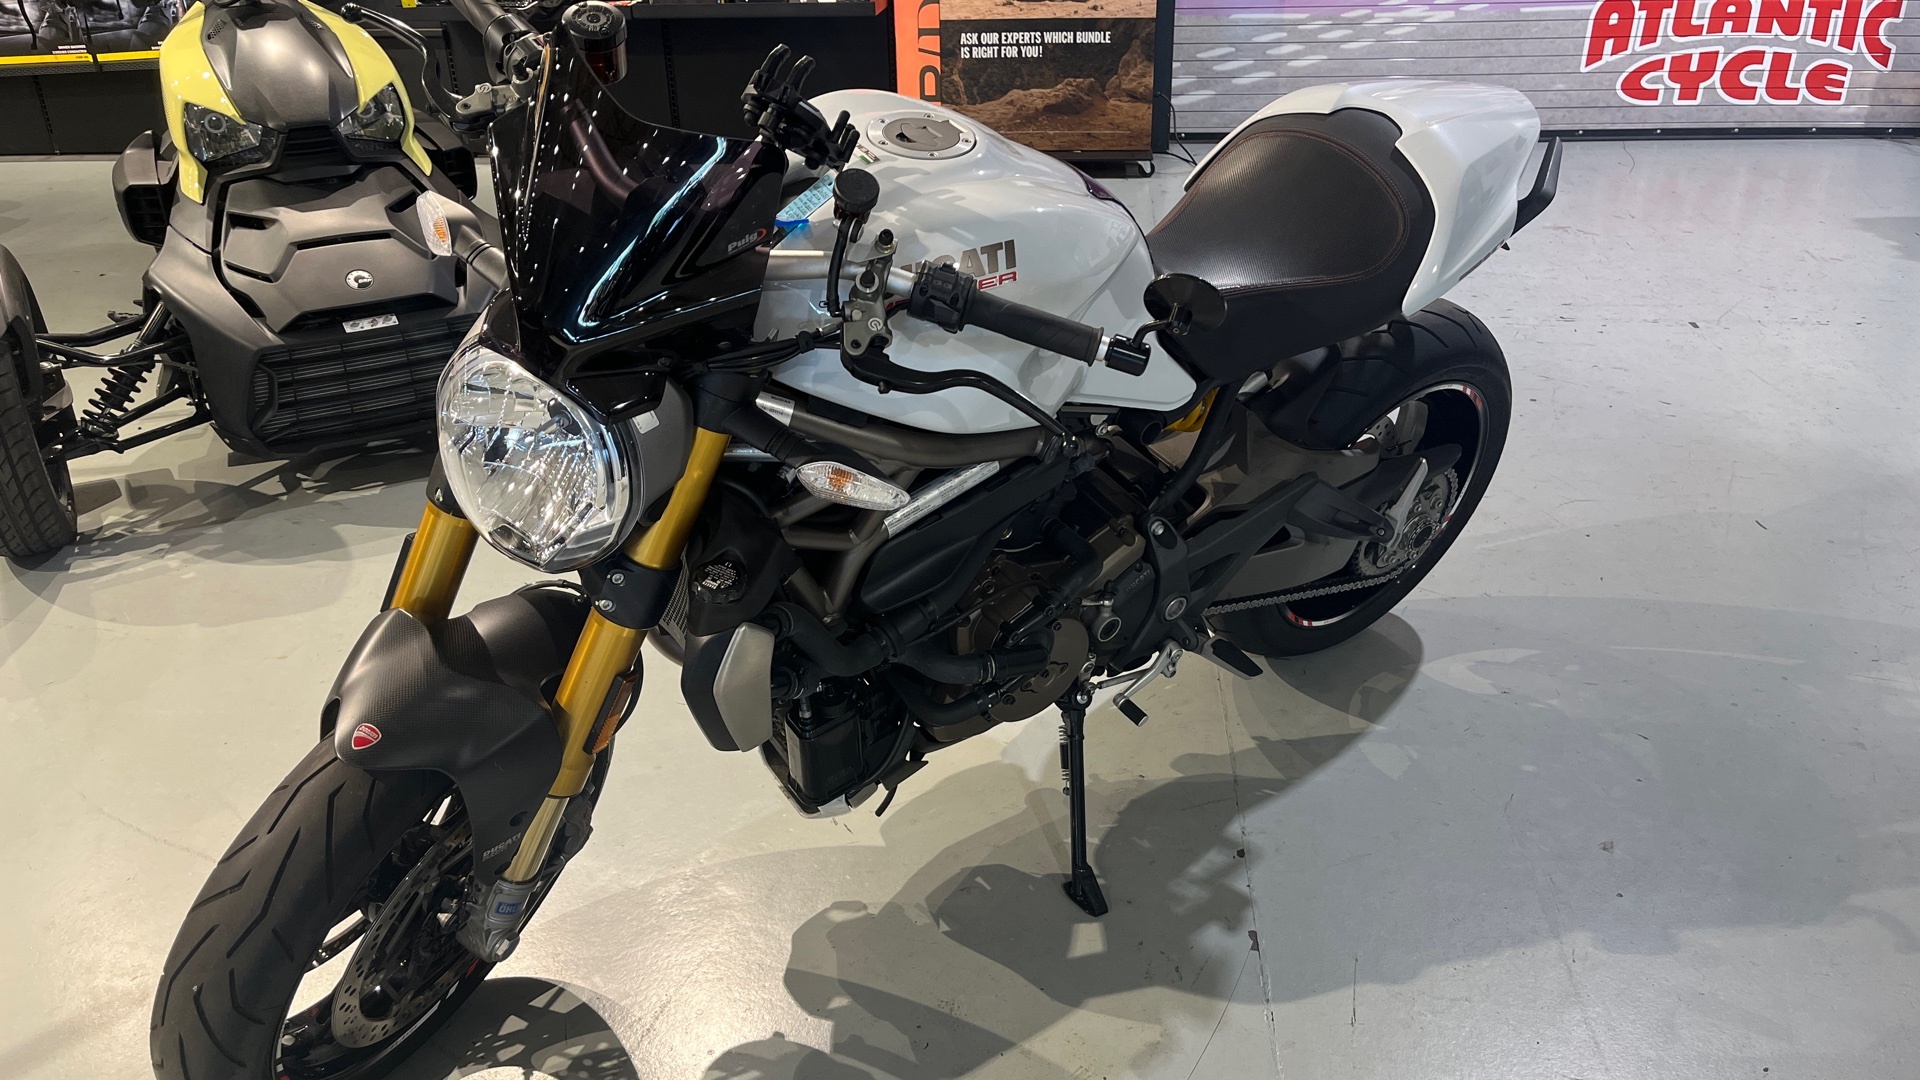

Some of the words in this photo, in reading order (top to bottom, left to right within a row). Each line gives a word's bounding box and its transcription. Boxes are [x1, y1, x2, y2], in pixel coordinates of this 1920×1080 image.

[960, 33, 979, 45] ASK
[980, 33, 999, 44] OUR
[1001, 32, 1042, 44] EXPERTS
[1043, 32, 1074, 44] WHICH
[1076, 31, 1111, 43] BUNDLE
[1582, 0, 1904, 70] ATLANTIC
[960, 47, 970, 58] IS
[972, 47, 999, 58] RIGHT
[1001, 46, 1019, 58] FOR
[1020, 46, 1043, 58] YOU!
[1617, 48, 1852, 103] CYCLE
[727, 232, 758, 252] Puig
[483, 832, 522, 857] DUCATI
[499, 903, 519, 915] ÖHL
